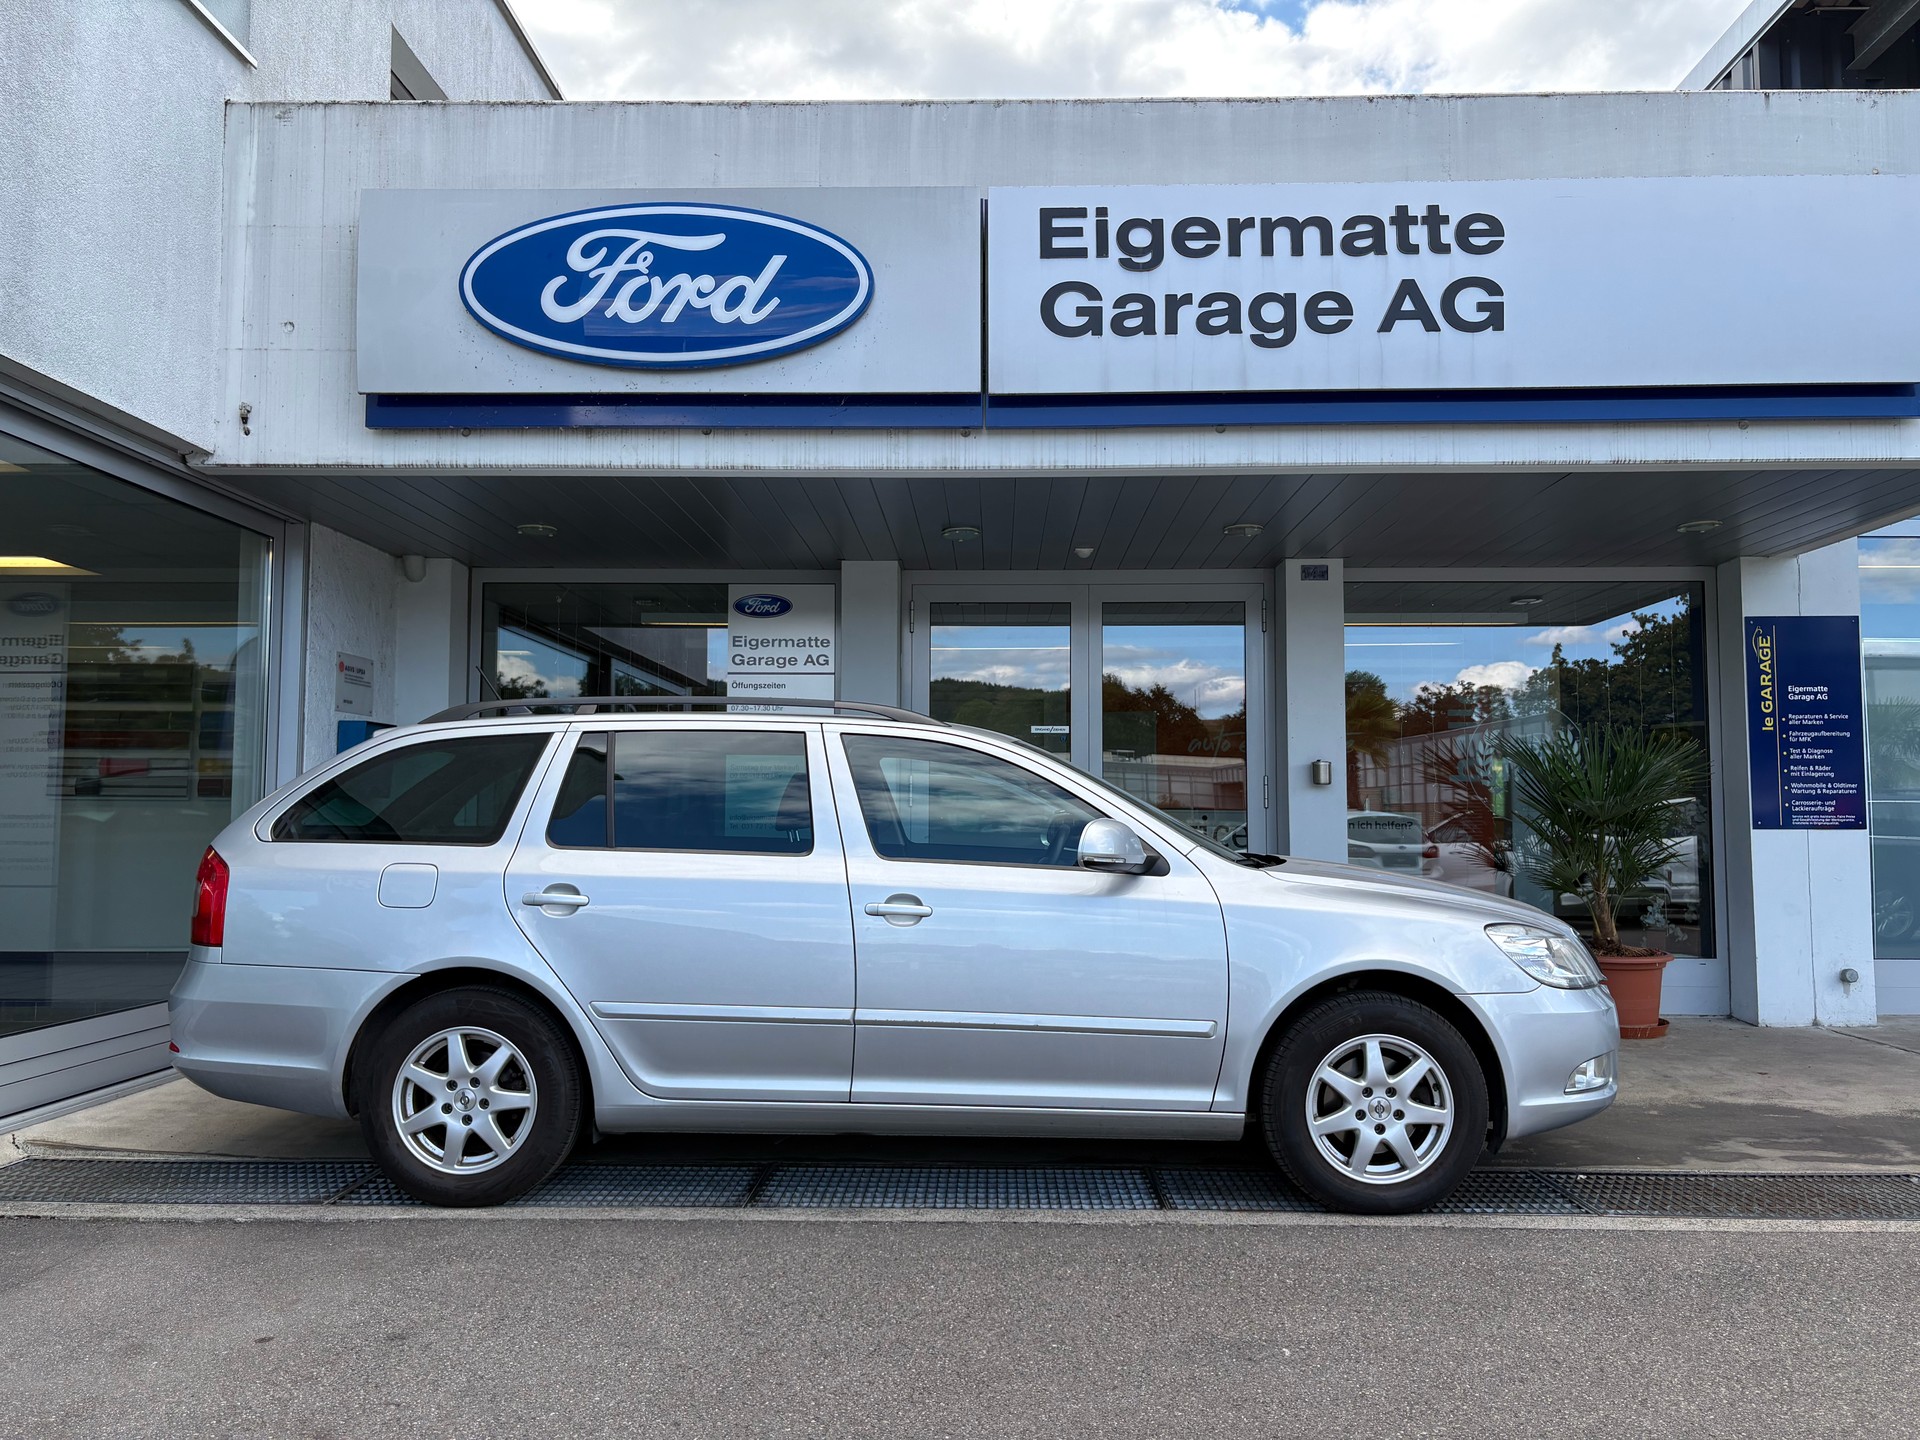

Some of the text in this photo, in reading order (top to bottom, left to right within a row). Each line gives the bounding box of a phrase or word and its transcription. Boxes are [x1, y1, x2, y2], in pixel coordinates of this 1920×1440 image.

[1038, 204, 1506, 272] Eigermatte
[540, 228, 788, 325] Ford
[1039, 276, 1506, 349] Garage AG
[744, 597, 781, 613] Ford
[732, 635, 831, 650] Eigermatte
[731, 653, 830, 669] Garage AG
[1759, 635, 1774, 731] le GARAGE
[1788, 685, 1829, 694] Eigermatte
[1788, 693, 1815, 701] Garage
[1789, 730, 1851, 738] Fahrzeugaufbereitung
[1791, 805, 1835, 813] Lackieraufträge
[1357, 821, 1373, 829] ich
[1374, 821, 1413, 829] helfen?
